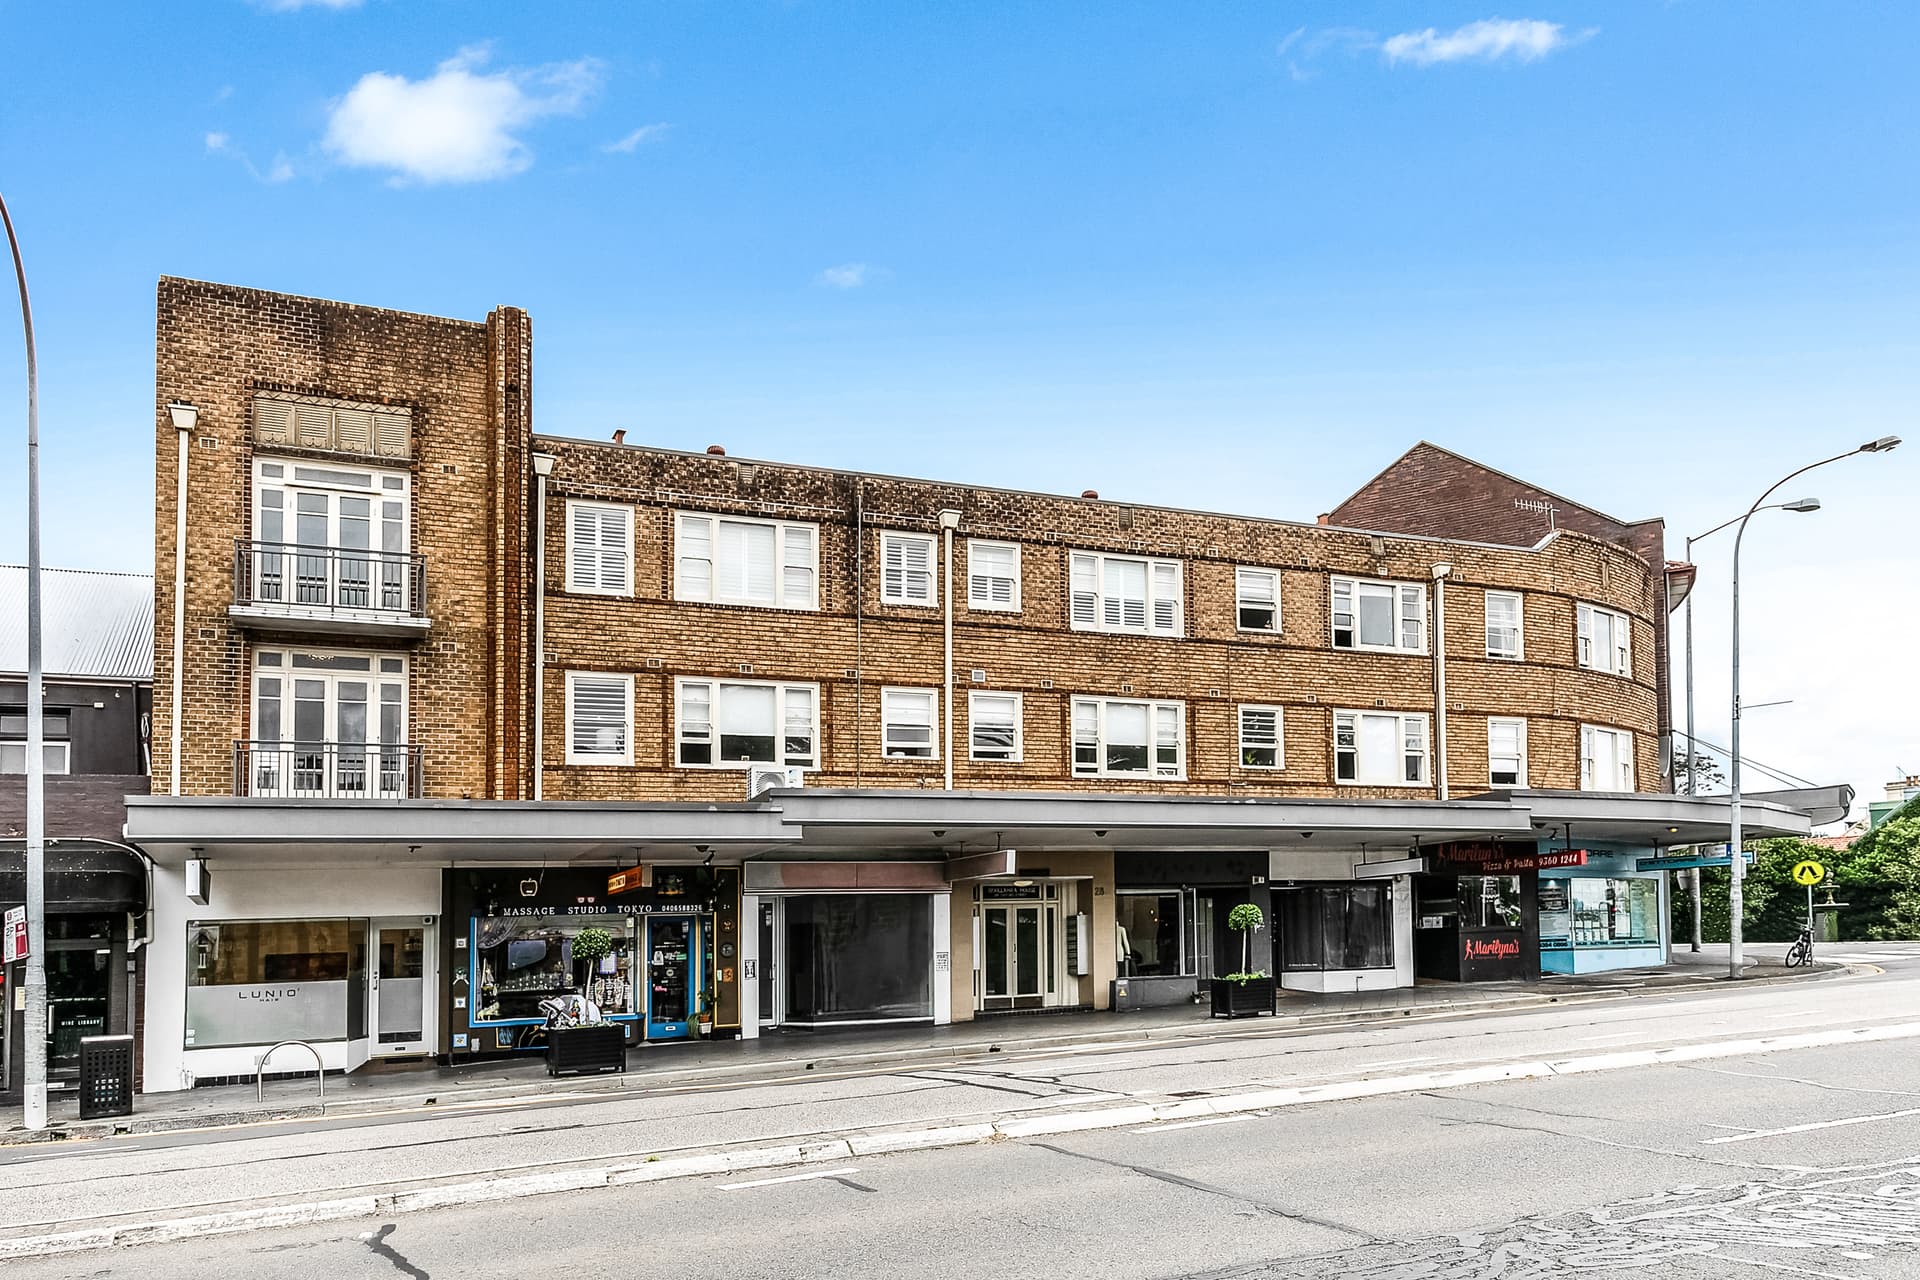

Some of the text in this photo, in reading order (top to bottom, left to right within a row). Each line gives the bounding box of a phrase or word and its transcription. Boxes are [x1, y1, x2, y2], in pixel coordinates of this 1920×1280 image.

[1538, 856, 1557, 866] 9360
[1560, 853, 1578, 864] 1244
[503, 907, 556, 916] MASSAGE
[567, 905, 607, 915] STUDIO
[617, 905, 652, 914] TOKYO
